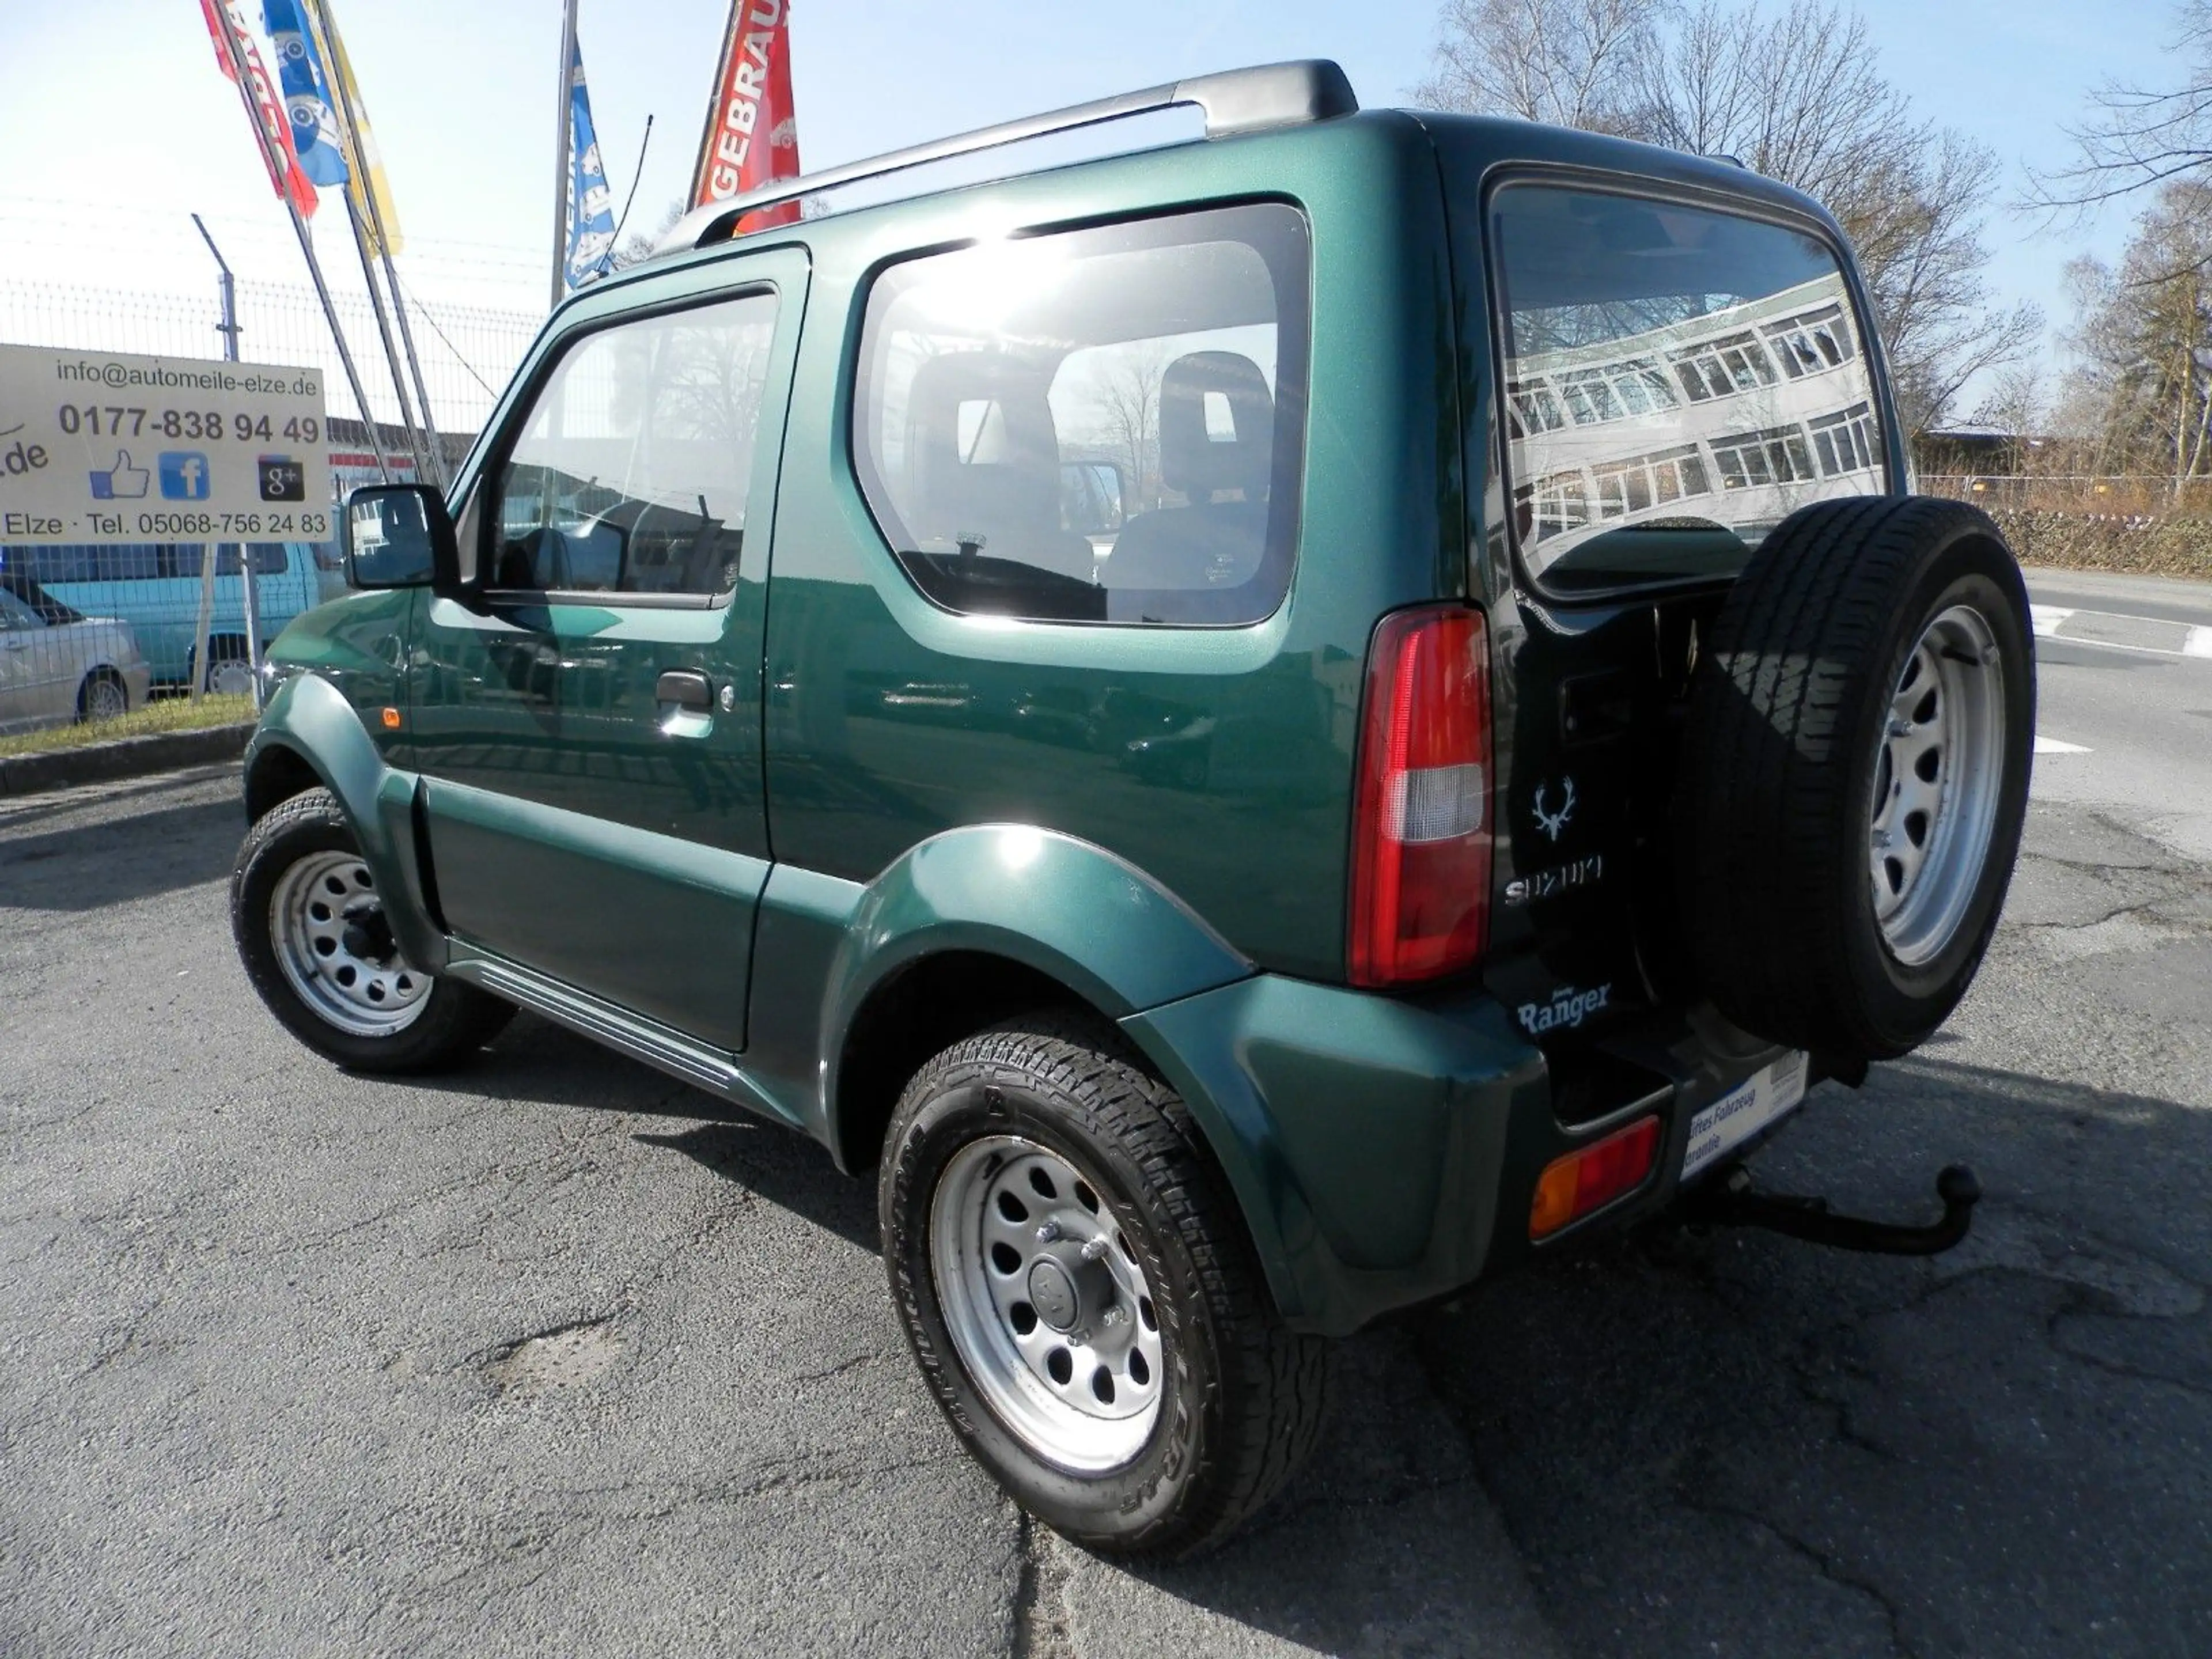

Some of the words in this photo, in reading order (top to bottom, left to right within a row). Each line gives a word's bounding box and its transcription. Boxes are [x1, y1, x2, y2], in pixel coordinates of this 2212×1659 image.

[58, 359, 316, 396] info@automeile-elze.de
[59, 404, 223, 440] 0177-838
[235, 413, 273, 442] 94
[283, 415, 319, 444] 49
[6, 513, 63, 535] Elze
[87, 513, 130, 535] Tel.
[139, 514, 261, 534] 05068-756
[268, 514, 293, 533] 24
[301, 514, 326, 534] 83
[1517, 982, 1611, 1034] Ranger
